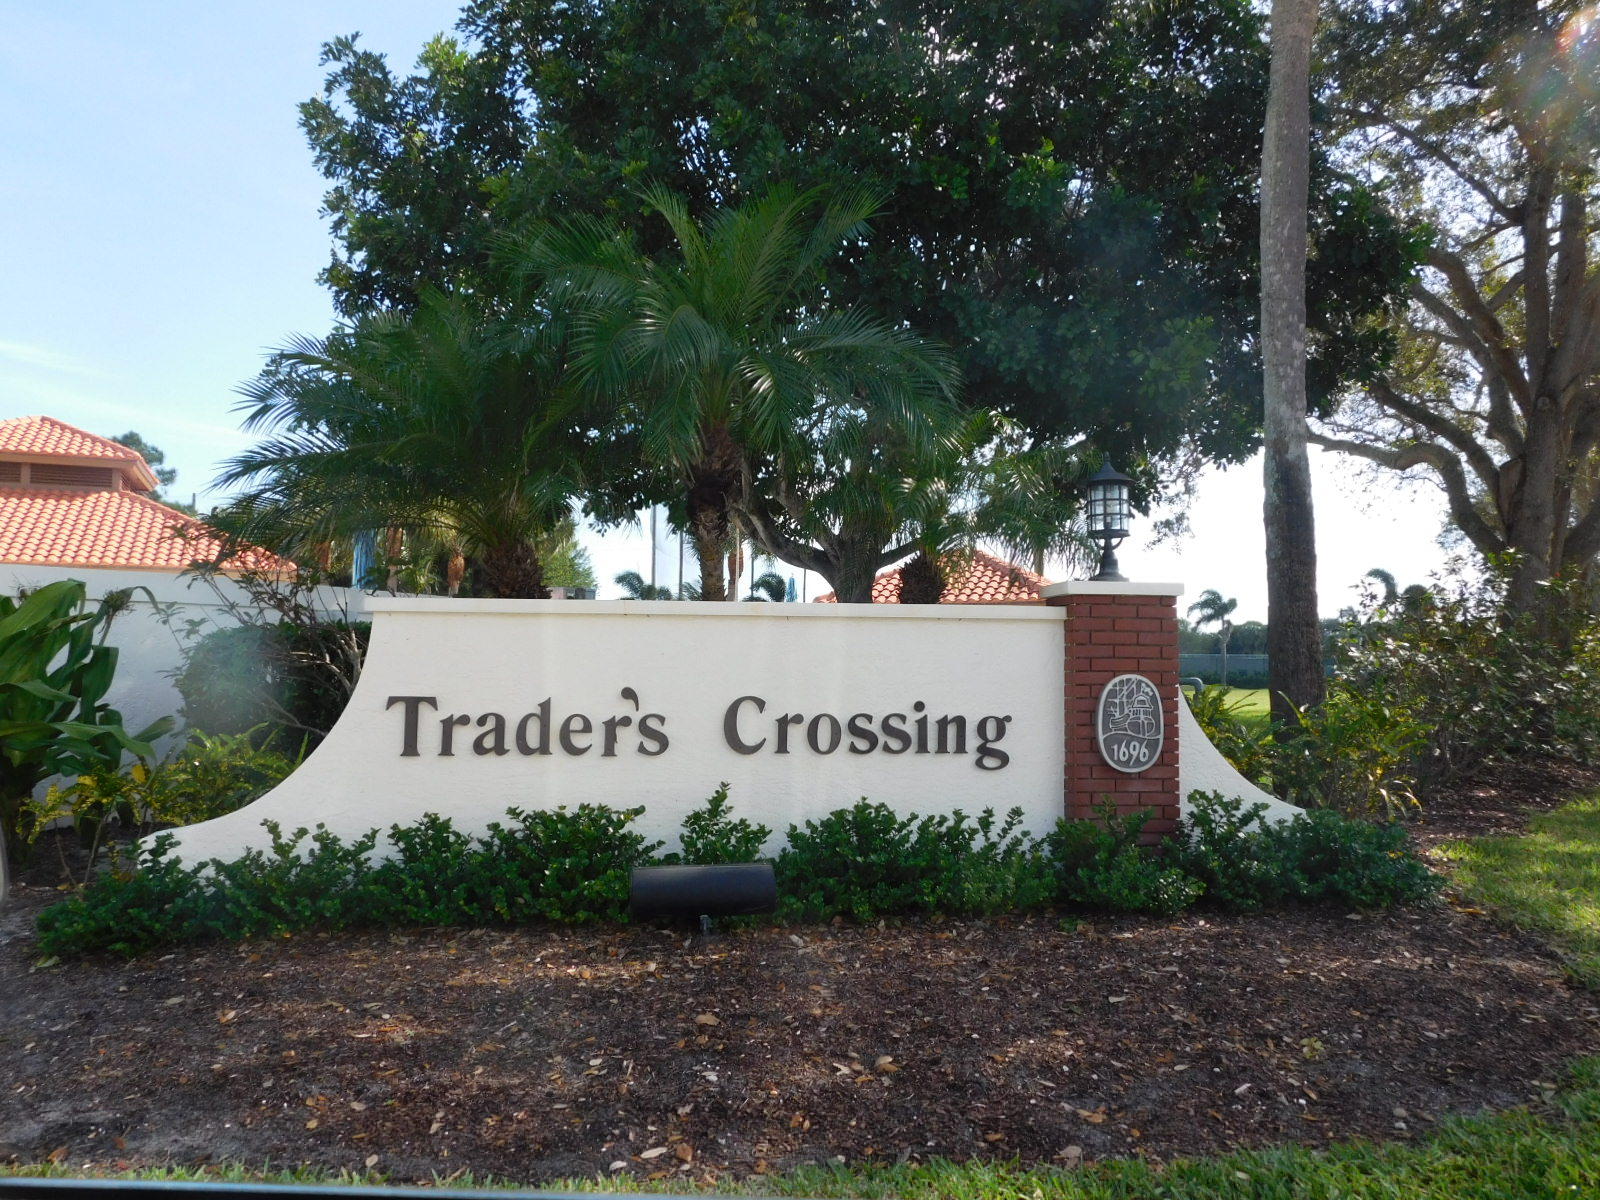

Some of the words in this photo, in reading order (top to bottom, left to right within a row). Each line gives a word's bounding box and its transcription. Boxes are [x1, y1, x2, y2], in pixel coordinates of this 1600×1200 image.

[385, 687, 670, 757] Trader's
[724, 695, 1013, 771] Crossing
[1111, 739, 1149, 766] 1696
